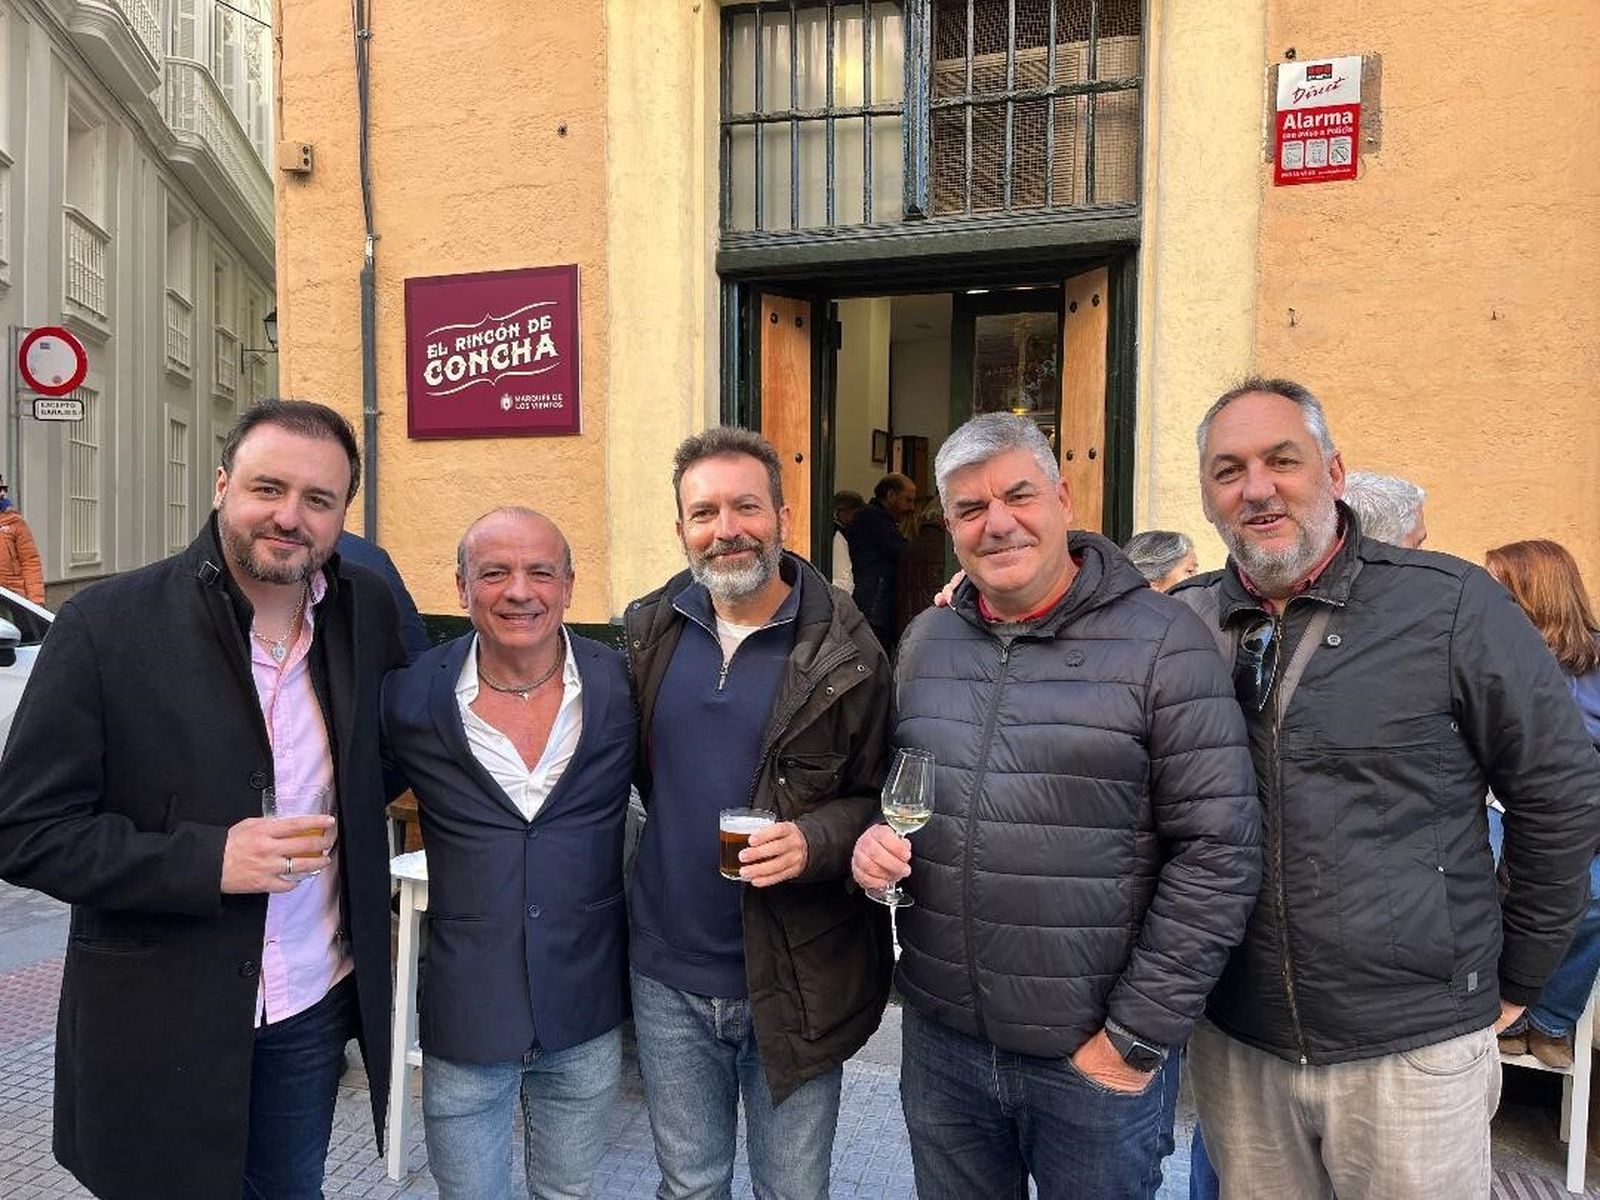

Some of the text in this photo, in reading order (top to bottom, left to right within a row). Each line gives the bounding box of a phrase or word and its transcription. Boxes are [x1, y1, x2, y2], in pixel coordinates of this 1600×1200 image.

[1283, 111, 1353, 130] Alarma
[427, 315, 552, 359] EL RINCÓN DE
[423, 333, 559, 386] CONCHA
[515, 402, 530, 410] LOS
[552, 392, 564, 401] DE
